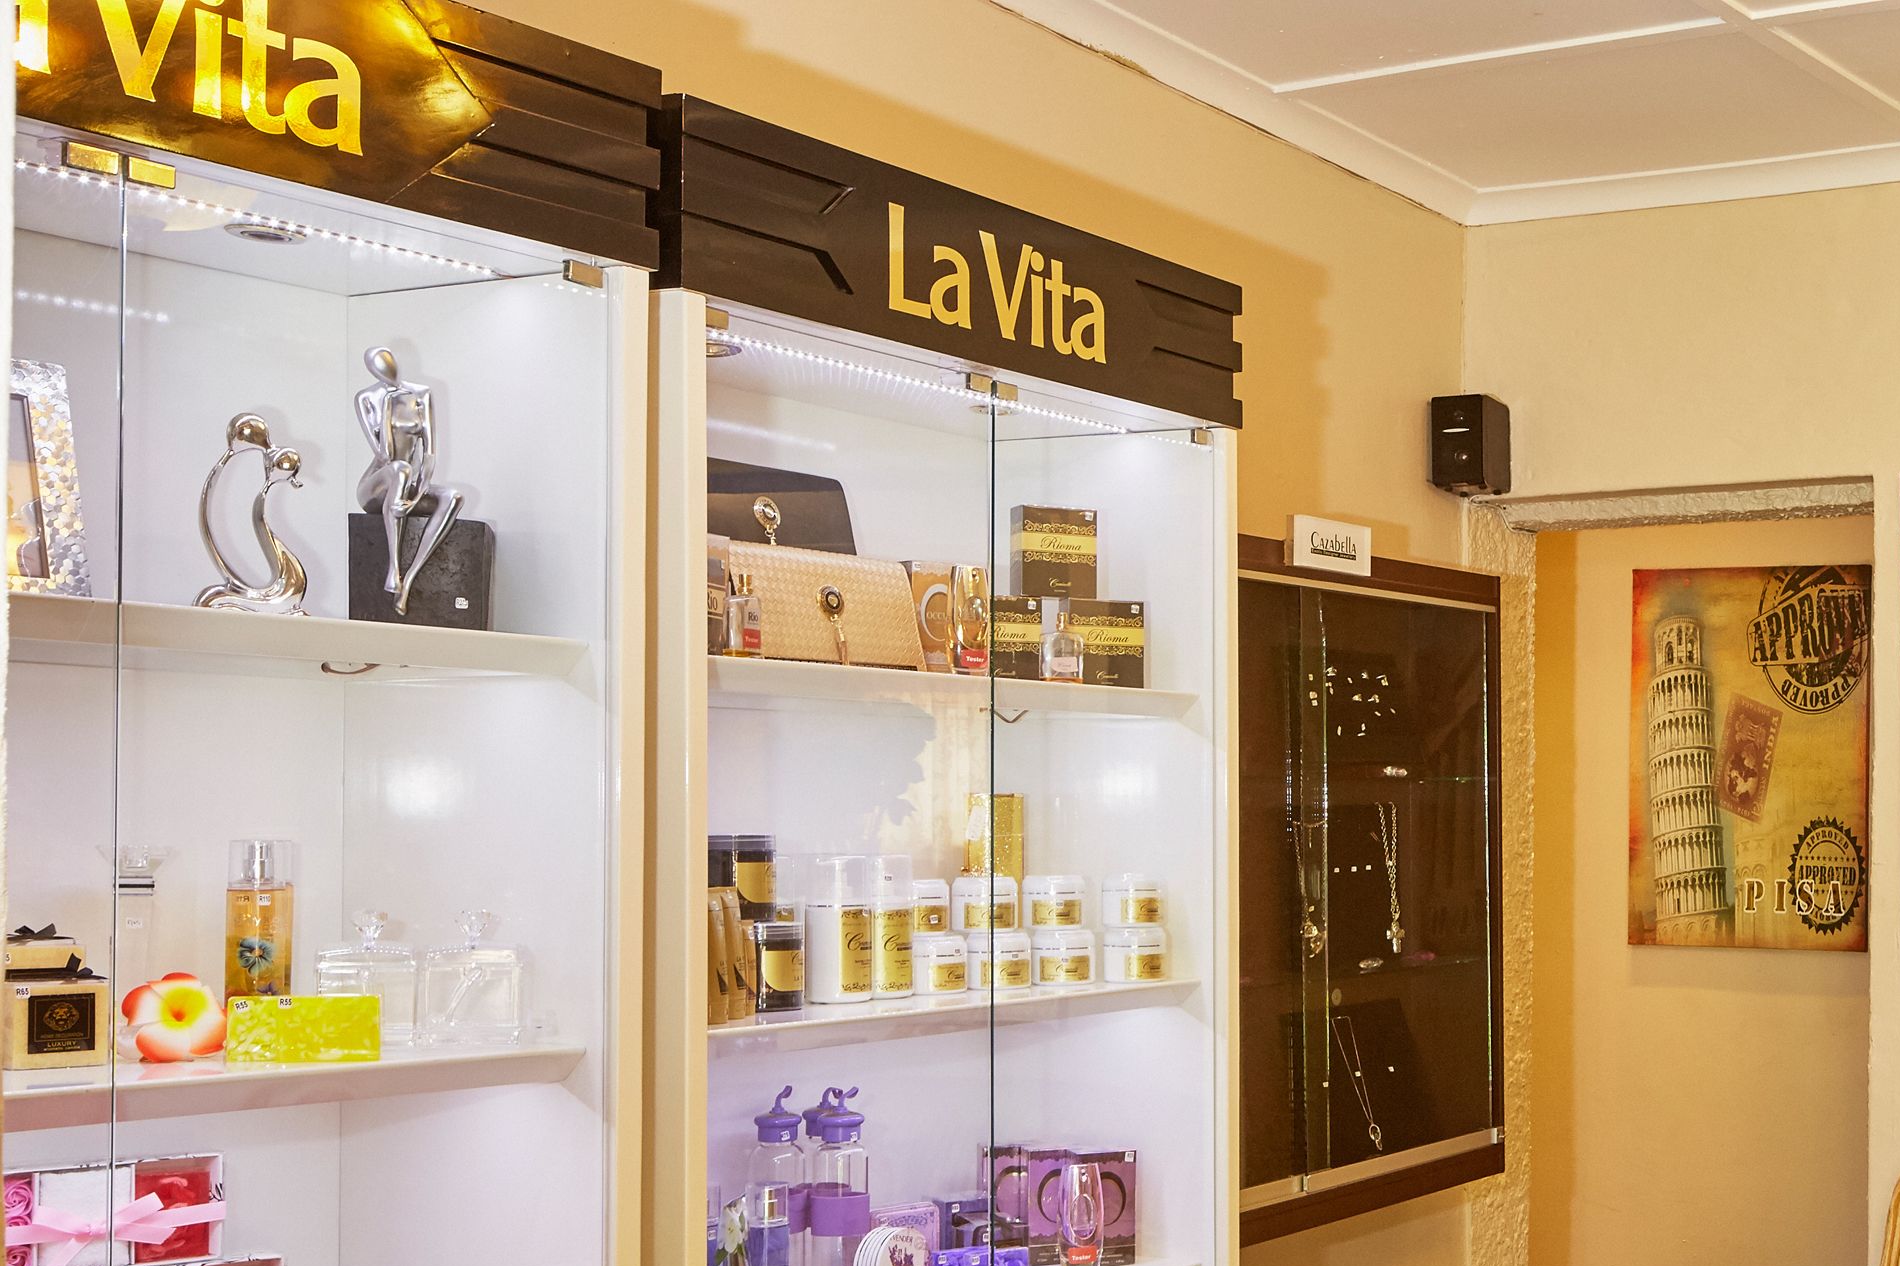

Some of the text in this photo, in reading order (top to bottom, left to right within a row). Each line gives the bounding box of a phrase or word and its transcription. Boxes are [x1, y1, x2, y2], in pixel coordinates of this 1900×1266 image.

[888, 201, 1107, 365] La Vita
[1040, 535, 1082, 551] Rioma
[1087, 629, 1129, 643] Rioma
[965, 655, 985, 664] Tester
[1762, 716, 1779, 770] INDIA
[1805, 829, 1850, 850] APPROVED
[1798, 865, 1857, 886] APPROVED
[1744, 878, 1845, 917] PISA
[235, 1001, 249, 1010] R55
[279, 998, 293, 1006] R55
[47, 1040, 77, 1048] LUXURY
[1071, 1253, 1092, 1261] Tester
